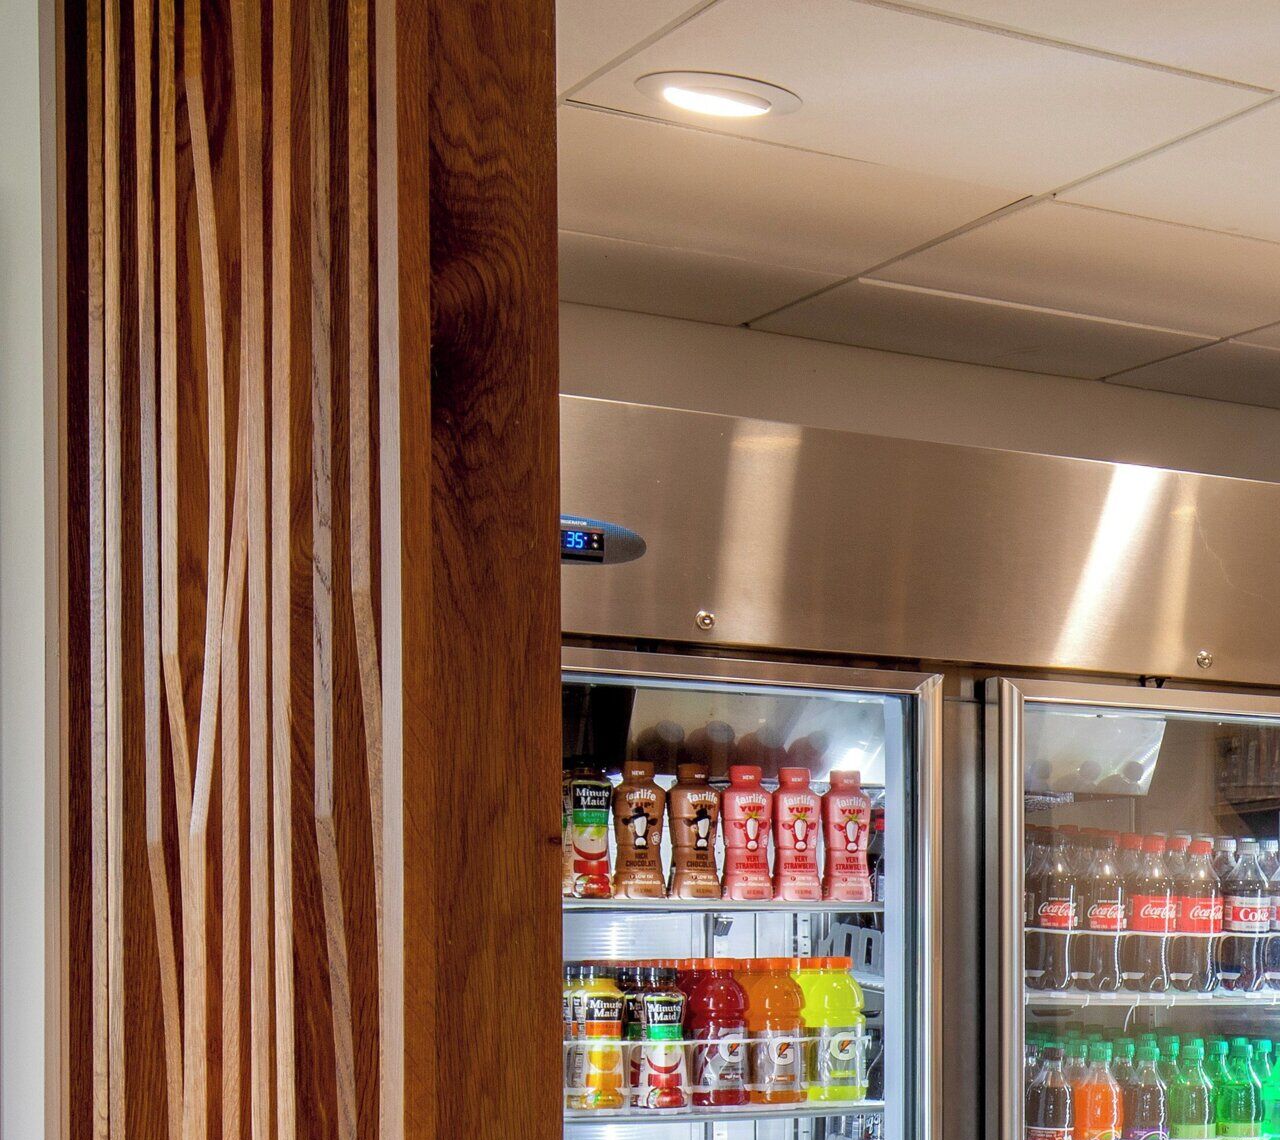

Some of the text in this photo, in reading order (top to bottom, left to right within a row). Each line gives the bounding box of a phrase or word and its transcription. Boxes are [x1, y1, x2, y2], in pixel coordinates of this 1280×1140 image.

[576, 788, 610, 797] Minute
[687, 792, 718, 803] fairlife
[580, 797, 607, 806] Maid
[735, 795, 767, 806] fairlife
[784, 796, 815, 806] fairlife
[836, 797, 867, 808] fairlife
[739, 805, 765, 813] YUP!
[788, 806, 813, 814] YUP!
[1239, 907, 1269, 921] Coke
[590, 1000, 622, 1009] Minute
[648, 1003, 681, 1013] Minute
[594, 1008, 619, 1018] Maid
[654, 1012, 677, 1021] Maid
